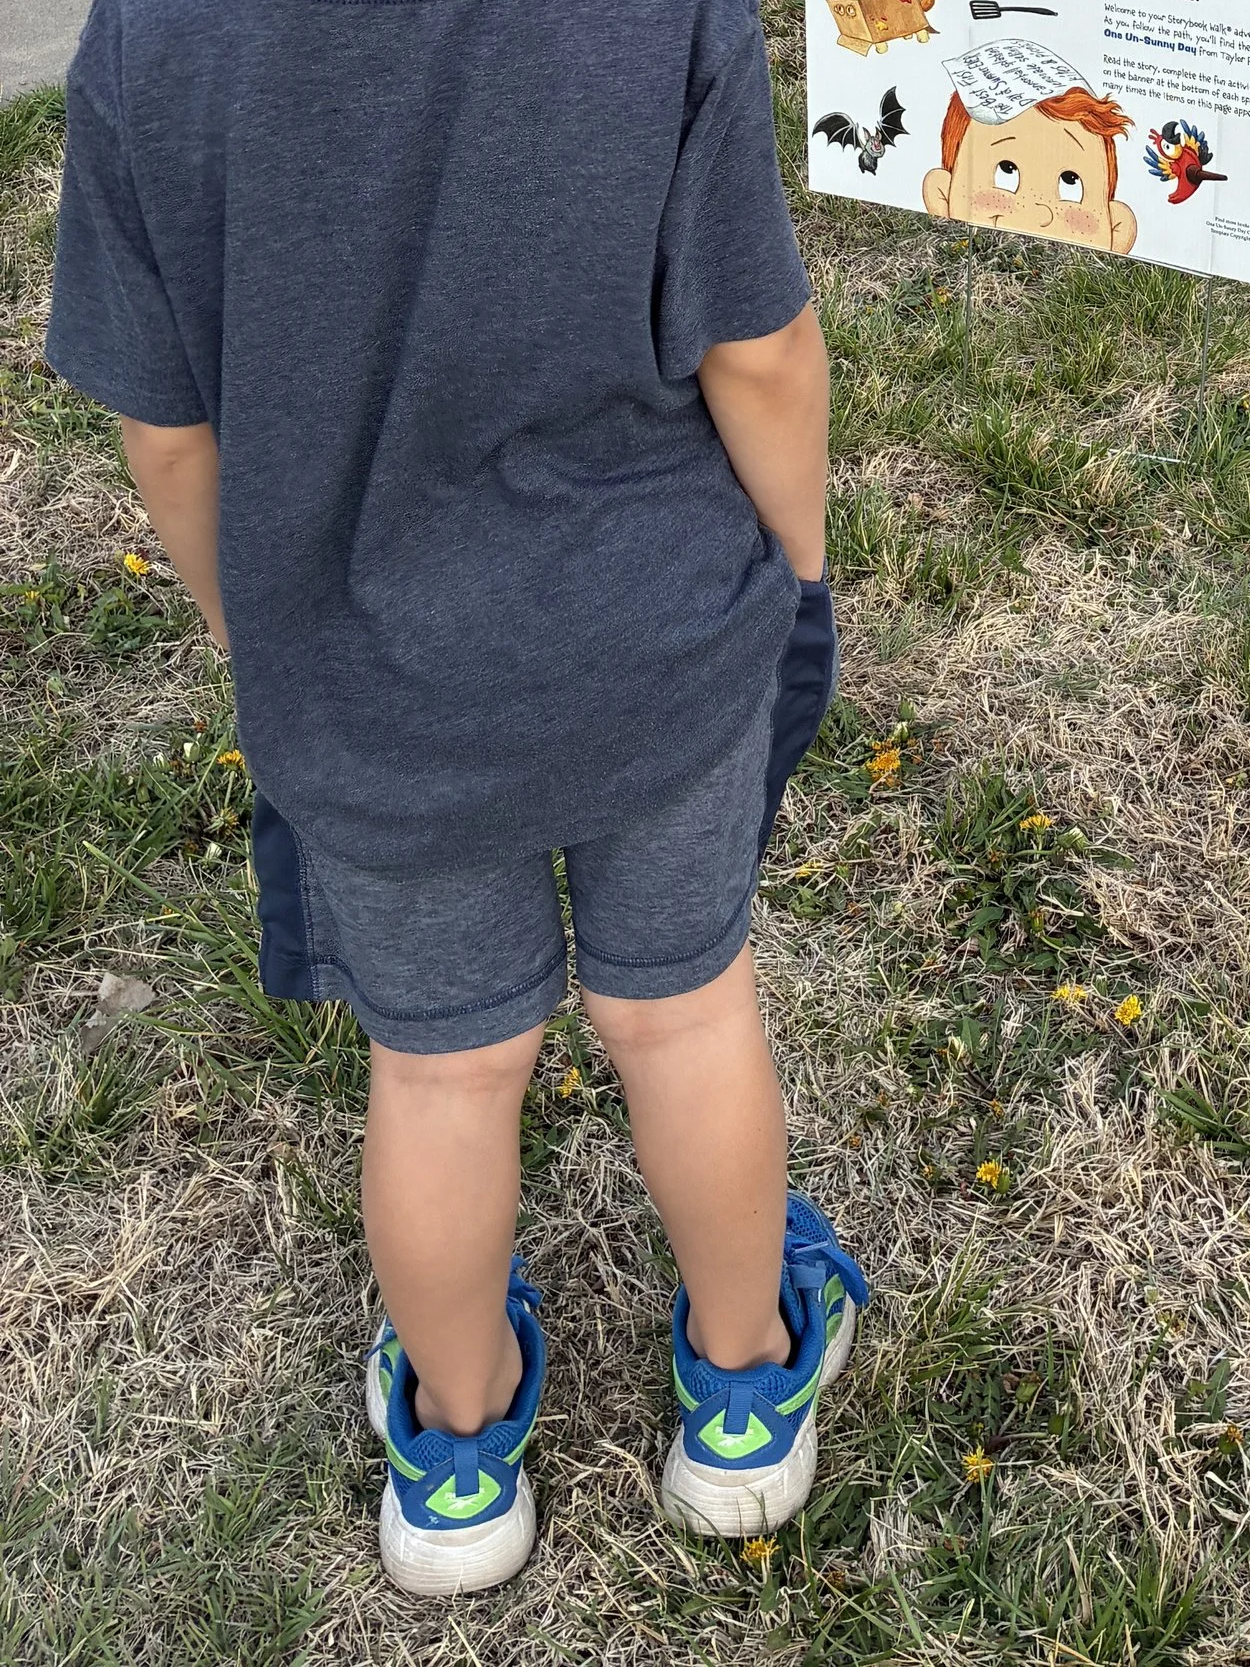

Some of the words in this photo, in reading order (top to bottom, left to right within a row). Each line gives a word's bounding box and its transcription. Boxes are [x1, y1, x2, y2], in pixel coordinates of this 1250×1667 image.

[1104, 3, 1136, 17] Welcome
[1138, 9, 1147, 18] to
[1148, 13, 1166, 23] your
[1167, 14, 1208, 32] Storybook
[1104, 16, 1113, 25] As
[1116, 19, 1130, 30] you
[1132, 20, 1155, 33] follow
[1158, 25, 1171, 36] the
[1173, 30, 1193, 42] path,
[1196, 34, 1217, 46] you'll
[1219, 37, 1235, 49] find
[1238, 41, 1250, 52] the
[1104, 28, 1123, 39] One
[1125, 32, 1176, 52] Un-Sunny
[1177, 42, 1197, 56] Day
[1198, 46, 1218, 57] from
[1220, 51, 1246, 65] Taylor
[952, 69, 979, 88] First
[1103, 54, 1121, 66] Read
[1123, 57, 1136, 68] the
[1137, 61, 1161, 75] story,
[1162, 67, 1197, 80] complete
[1199, 72, 1212, 84] the
[1214, 74, 1226, 86] fun
[1114, 68, 1126, 79] the
[1128, 71, 1155, 84] banner
[1156, 77, 1165, 87] at
[1167, 79, 1179, 90] the
[1181, 81, 1210, 95] bottom
[1211, 88, 1221, 99] of
[1222, 91, 1239, 102] each
[969, 88, 997, 110] Best
[1008, 91, 1038, 107] Day
[1102, 81, 1123, 94] many
[1125, 84, 1147, 97] times
[1149, 88, 1162, 99] the
[1198, 97, 1213, 110] this
[1214, 103, 1232, 116] page
